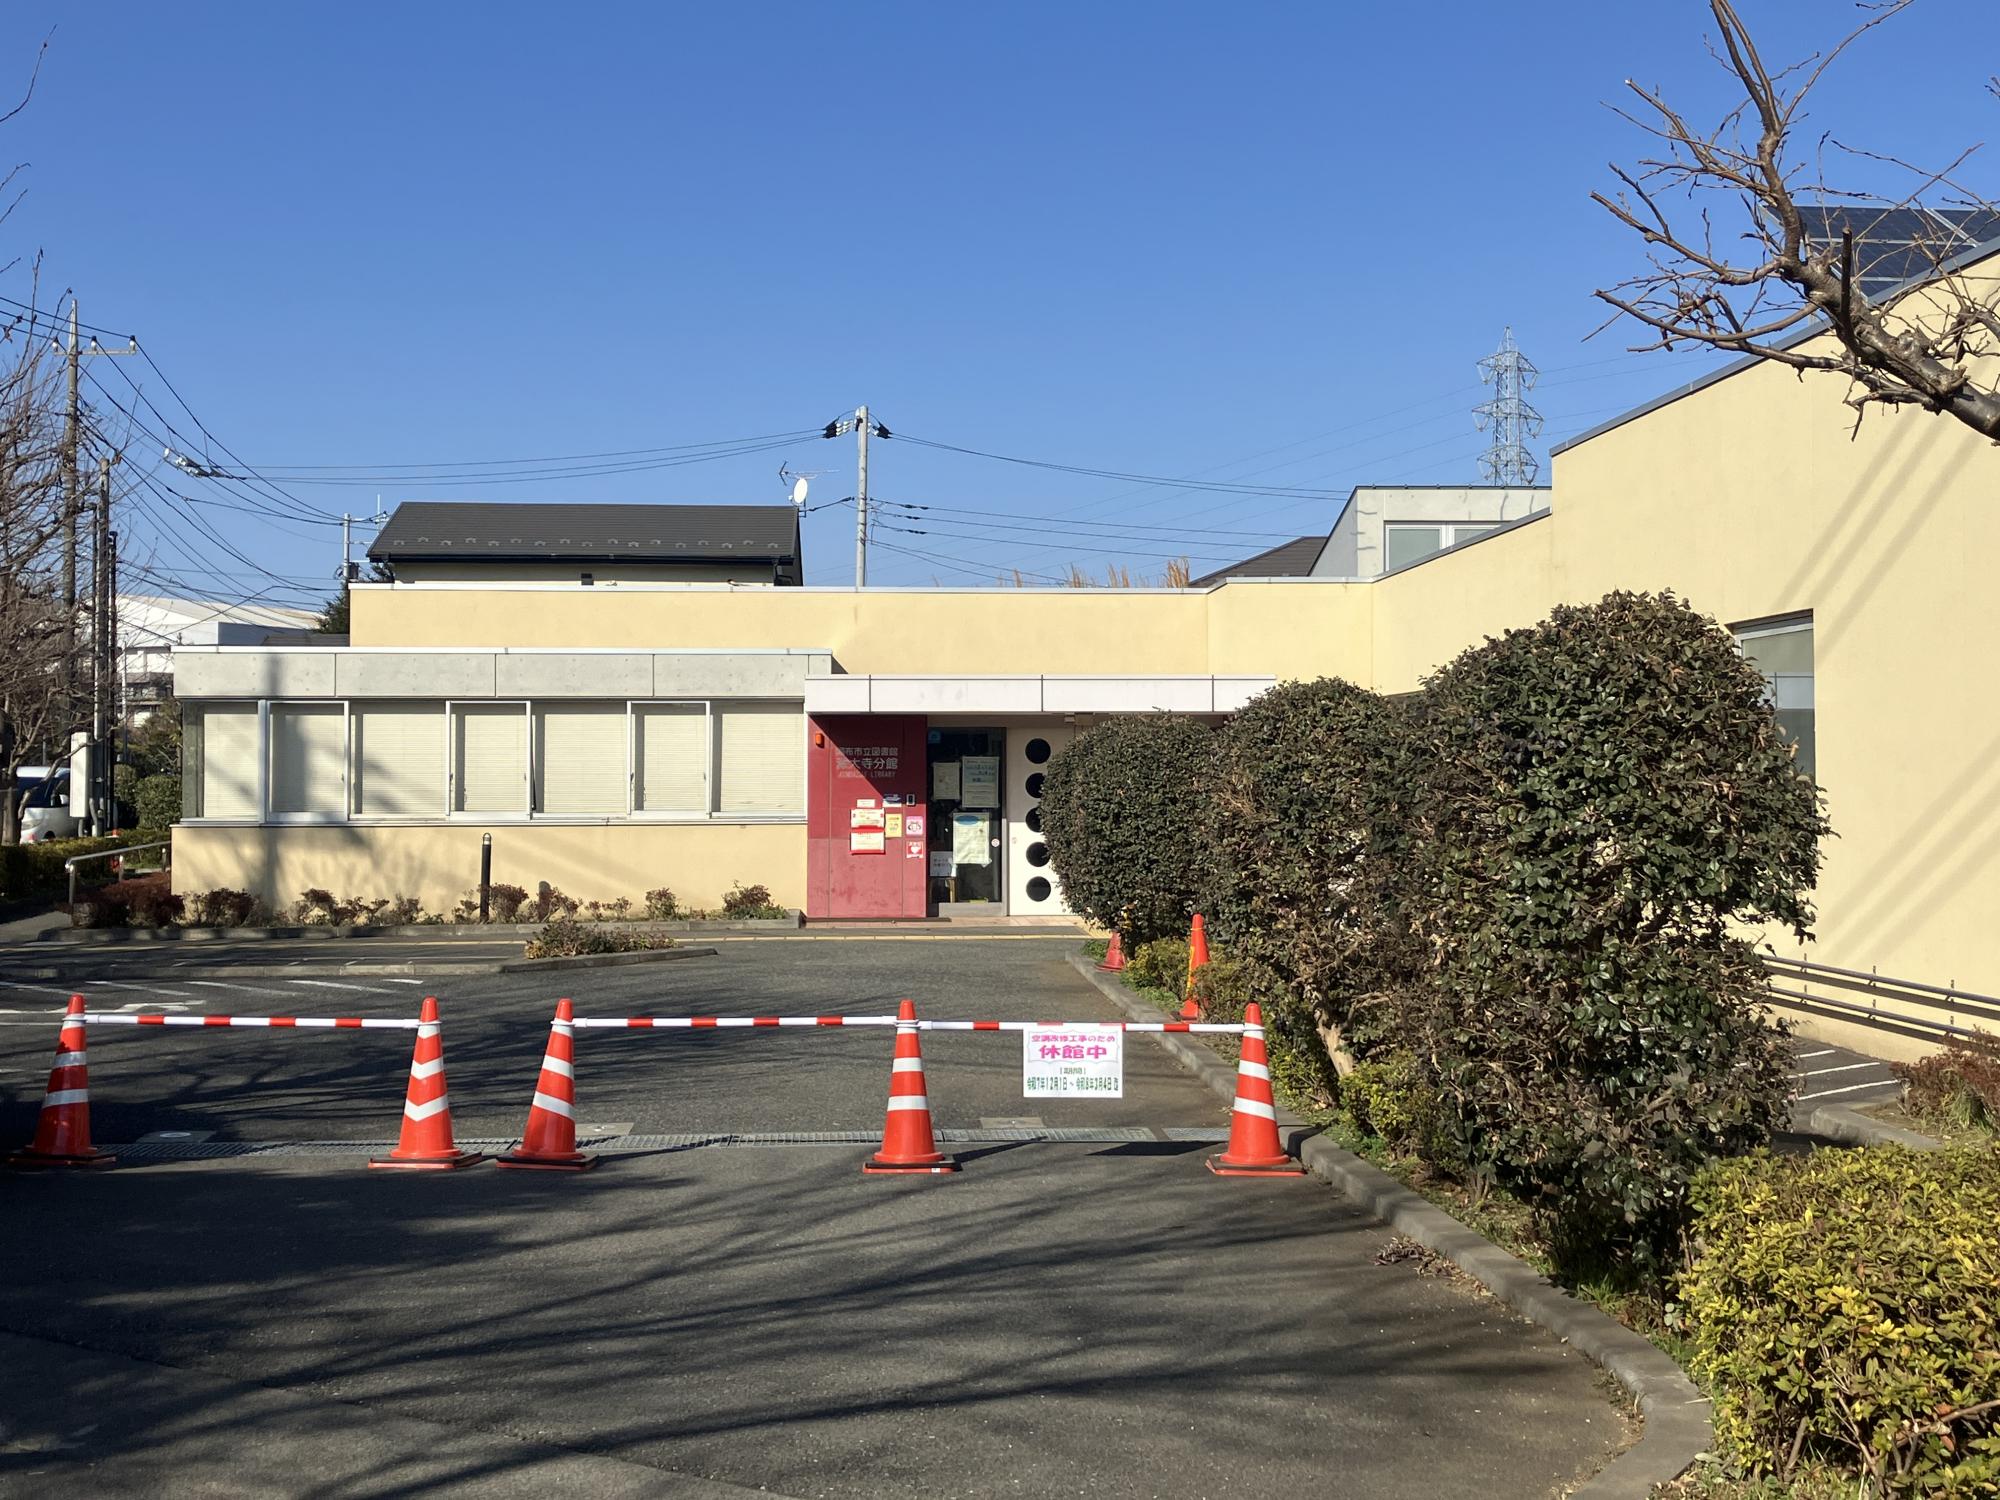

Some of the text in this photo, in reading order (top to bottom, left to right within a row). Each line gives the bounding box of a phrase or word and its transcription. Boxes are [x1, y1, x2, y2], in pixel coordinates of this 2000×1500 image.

[1032, 1034, 1115, 1042] 空調改修工事のため
[1039, 1045, 1107, 1059] 休館中
